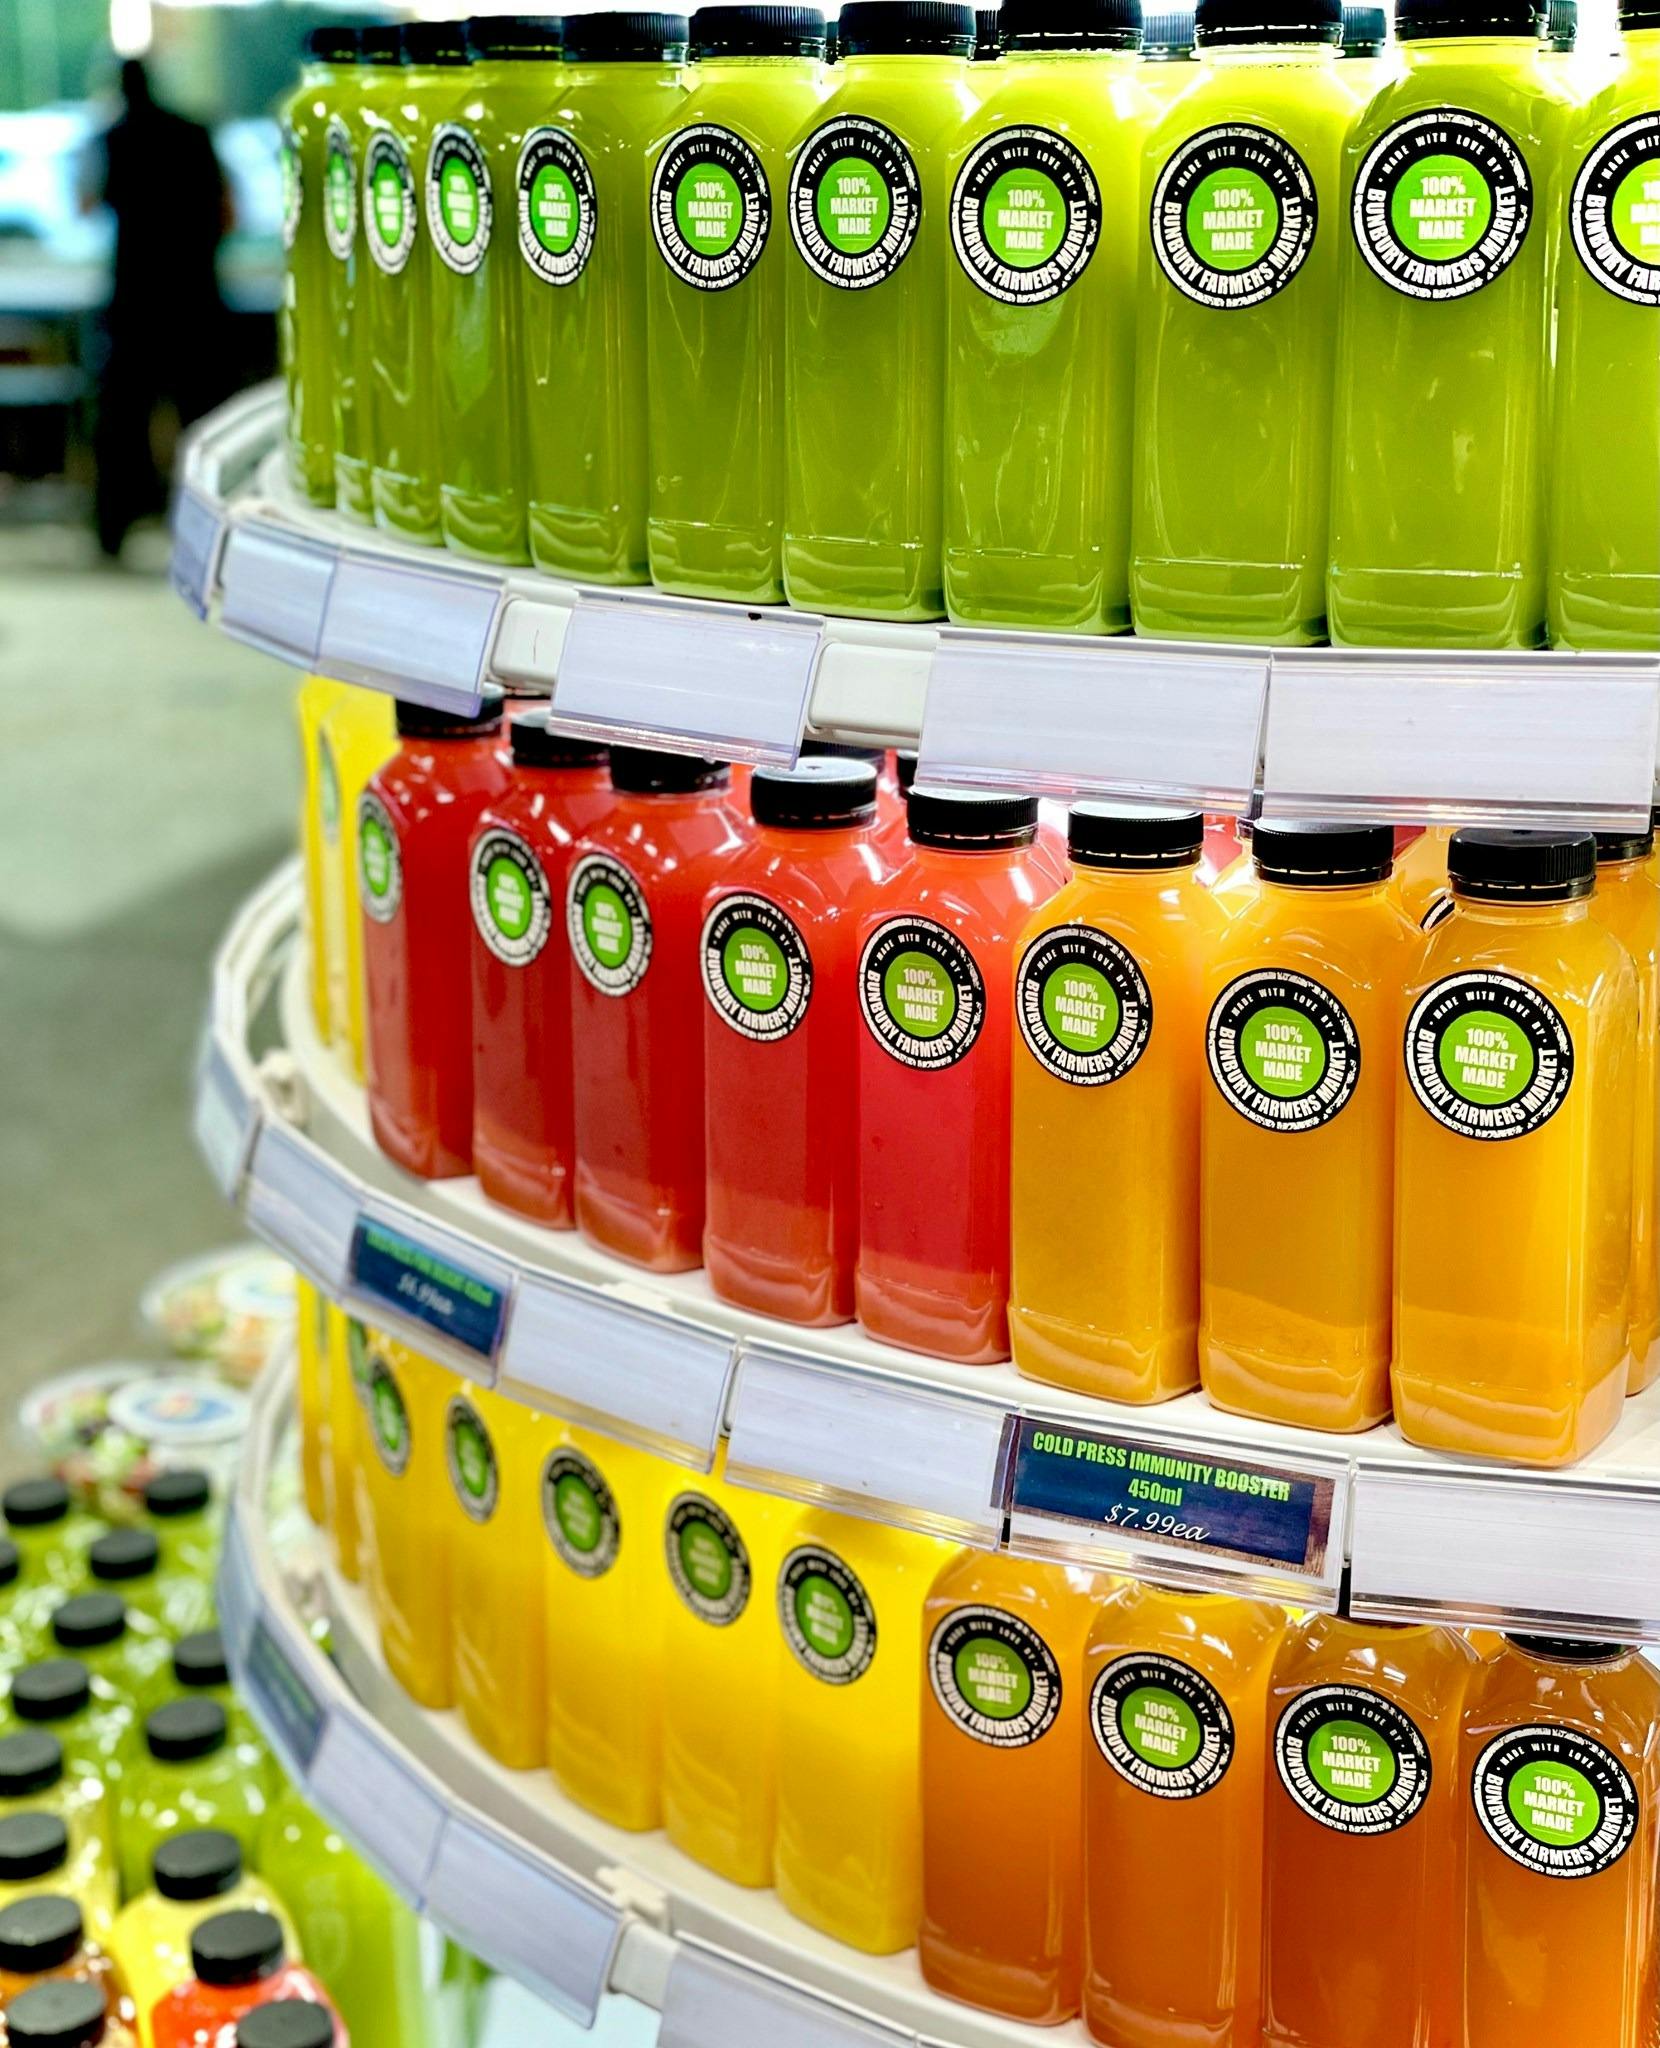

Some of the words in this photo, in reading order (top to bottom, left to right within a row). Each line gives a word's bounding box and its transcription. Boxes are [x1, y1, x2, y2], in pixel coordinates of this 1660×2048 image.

[668, 154, 686, 179] MADE
[689, 144, 711, 157] WITH
[717, 146, 737, 166] LOVE
[738, 166, 749, 181] BY
[808, 149, 828, 176] MADE
[831, 137, 856, 151] WITH
[862, 139, 884, 159] LOVE
[885, 160, 897, 175] BY
[1382, 145, 1410, 175] MADE
[1415, 133, 1448, 148] WITH
[1457, 135, 1486, 156] LOVE
[1487, 157, 1503, 173] BY
[1601, 149, 1630, 180] MADE
[975, 157, 998, 185] MADE
[1003, 147, 1030, 161] WITH
[1037, 150, 1062, 171] LOVE
[1063, 172, 1076, 188] BY
[1177, 159, 1202, 188] MADE
[1207, 146, 1237, 162] WITH
[1245, 148, 1272, 169] LOVE
[1274, 169, 1289, 185] BY
[693, 182, 725, 200] 100%
[836, 178, 871, 196] 100%
[1006, 189, 1045, 208] 100%
[1211, 189, 1254, 209] 100%
[1419, 177, 1465, 197] 100%
[686, 201, 733, 220] MARKET
[828, 197, 878, 216] MARKET
[1407, 198, 1475, 219] MARKET
[693, 221, 727, 239] MADE
[835, 218, 871, 236] MADE
[996, 209, 1053, 229] MARKET
[1201, 210, 1264, 231] MARKET
[1416, 221, 1464, 241] MADE
[659, 189, 691, 264] BUNBURY
[686, 250, 743, 278] FARMERS
[736, 192, 761, 258] MARKET
[798, 187, 832, 263] BUNBURY
[827, 247, 889, 277] FARMERS
[882, 186, 909, 255] MARKET
[1003, 230, 1043, 250] MADE
[1210, 232, 1254, 252] MADE
[1366, 187, 1409, 272] BUNBURY
[1403, 252, 1487, 287] FARMERS
[1479, 185, 1517, 261] MARKET
[1585, 194, 1632, 279] BUNBURY
[962, 196, 998, 276] BUNBURY
[992, 261, 1062, 292] FARMERS
[1056, 200, 1088, 271] MARKET
[1164, 201, 1204, 282] BUNBURY
[1198, 262, 1276, 296] FARMERS
[1268, 196, 1303, 271] MARKET
[714, 917, 731, 939] MADE
[733, 911, 754, 921] WITH
[759, 914, 778, 933] LOVE
[780, 934, 791, 947] BY
[739, 944, 770, 962] 100%
[876, 940, 895, 962] MADE
[898, 934, 921, 944] WITH
[927, 938, 949, 958] LOVE
[950, 959, 962, 973] BY
[734, 960, 777, 979] MARKET
[903, 968, 937, 988] 100%
[1037, 949, 1058, 971] MADE
[1062, 944, 1087, 955] WITH
[1093, 950, 1116, 971] LOVE
[1116, 974, 1129, 988] BY
[708, 947, 740, 1016] BUNBURY
[737, 1007, 790, 1031] FARMERS
[783, 957, 803, 1016] MARKET
[741, 978, 773, 996] MADE
[896, 984, 944, 1006] MARKET
[1064, 980, 1100, 1002] 100%
[867, 969, 900, 1041] BUNBURY
[895, 1033, 955, 1059] FARMERS
[948, 984, 974, 1044] MARKET
[903, 1003, 937, 1023] MADE
[1055, 996, 1107, 1021] MARKET
[1231, 994, 1255, 1017] MADE
[1259, 988, 1287, 999] WITH
[1294, 992, 1319, 1013] LOVE
[1320, 1015, 1334, 1029] BY
[1433, 996, 1460, 1020] MADE
[1465, 991, 1496, 1002] WITH
[1504, 996, 1531, 1019] LOVE
[1532, 1021, 1546, 1036] BY
[1025, 979, 1056, 1053] BUNBURY
[1051, 1046, 1115, 1074] FARMERS
[1109, 999, 1140, 1062] MARKET
[1061, 1015, 1098, 1038] MADE
[1263, 1024, 1303, 1045] 100%
[1467, 1028, 1510, 1051] 100%
[1254, 1041, 1311, 1064] MARKET
[1455, 1046, 1519, 1071] MARKET
[1218, 1026, 1256, 1101] BUNBURY
[1251, 1093, 1323, 1120] FARMERS
[1316, 1040, 1347, 1104] MARKET
[1262, 1061, 1303, 1082] MADE
[1417, 1028, 1455, 1107] BUNBURY
[1448, 1099, 1527, 1128] FARMERS
[1520, 1048, 1558, 1114] MARKET
[1462, 1066, 1507, 1089] MADE
[1032, 1431, 1074, 1457] COLD
[1076, 1440, 1127, 1467] PRESS
[1129, 1451, 1213, 1485] IMMUNITY
[1214, 1468, 1291, 1501] BOOSTER
[1128, 1478, 1183, 1507] 450ml
[1104, 1502, 1211, 1541] $7.99ea
[1114, 1672, 1137, 1691] MADE
[1141, 1670, 1167, 1681] WITH
[1173, 1678, 1197, 1699] LOVE
[1198, 1702, 1210, 1715] BY
[1143, 1701, 1180, 1724] 100%
[1298, 1707, 1322, 1728] MADE
[1326, 1702, 1354, 1712] WITH
[1362, 1707, 1388, 1727] LOVE
[1389, 1729, 1403, 1742] BY
[1133, 1714, 1188, 1742] MARKET
[1101, 1695, 1135, 1764] BUNBURY
[1129, 1759, 1197, 1788] FARMERS
[1190, 1725, 1222, 1780] MARKET
[1140, 1732, 1179, 1756] MADE
[1331, 1736, 1372, 1755] 100%
[1322, 1751, 1381, 1773] MARKET
[1500, 1746, 1526, 1767] MADE
[1531, 1742, 1561, 1753] WITH
[1568, 1749, 1595, 1769] LOVE
[1597, 1772, 1611, 1786] BY
[1286, 1735, 1326, 1806] BUNBURY
[1321, 1798, 1395, 1824] FARMERS
[1387, 1752, 1418, 1811] MARKET
[1331, 1769, 1373, 1790] MADE
[1534, 1776, 1577, 1797] 100%
[1523, 1790, 1586, 1816] MARKET
[1485, 1773, 1524, 1845] BUNBURY
[1518, 1838, 1596, 1866] FARMERS
[1589, 1796, 1624, 1855] MARKET
[1531, 1809, 1575, 1832] MADE
